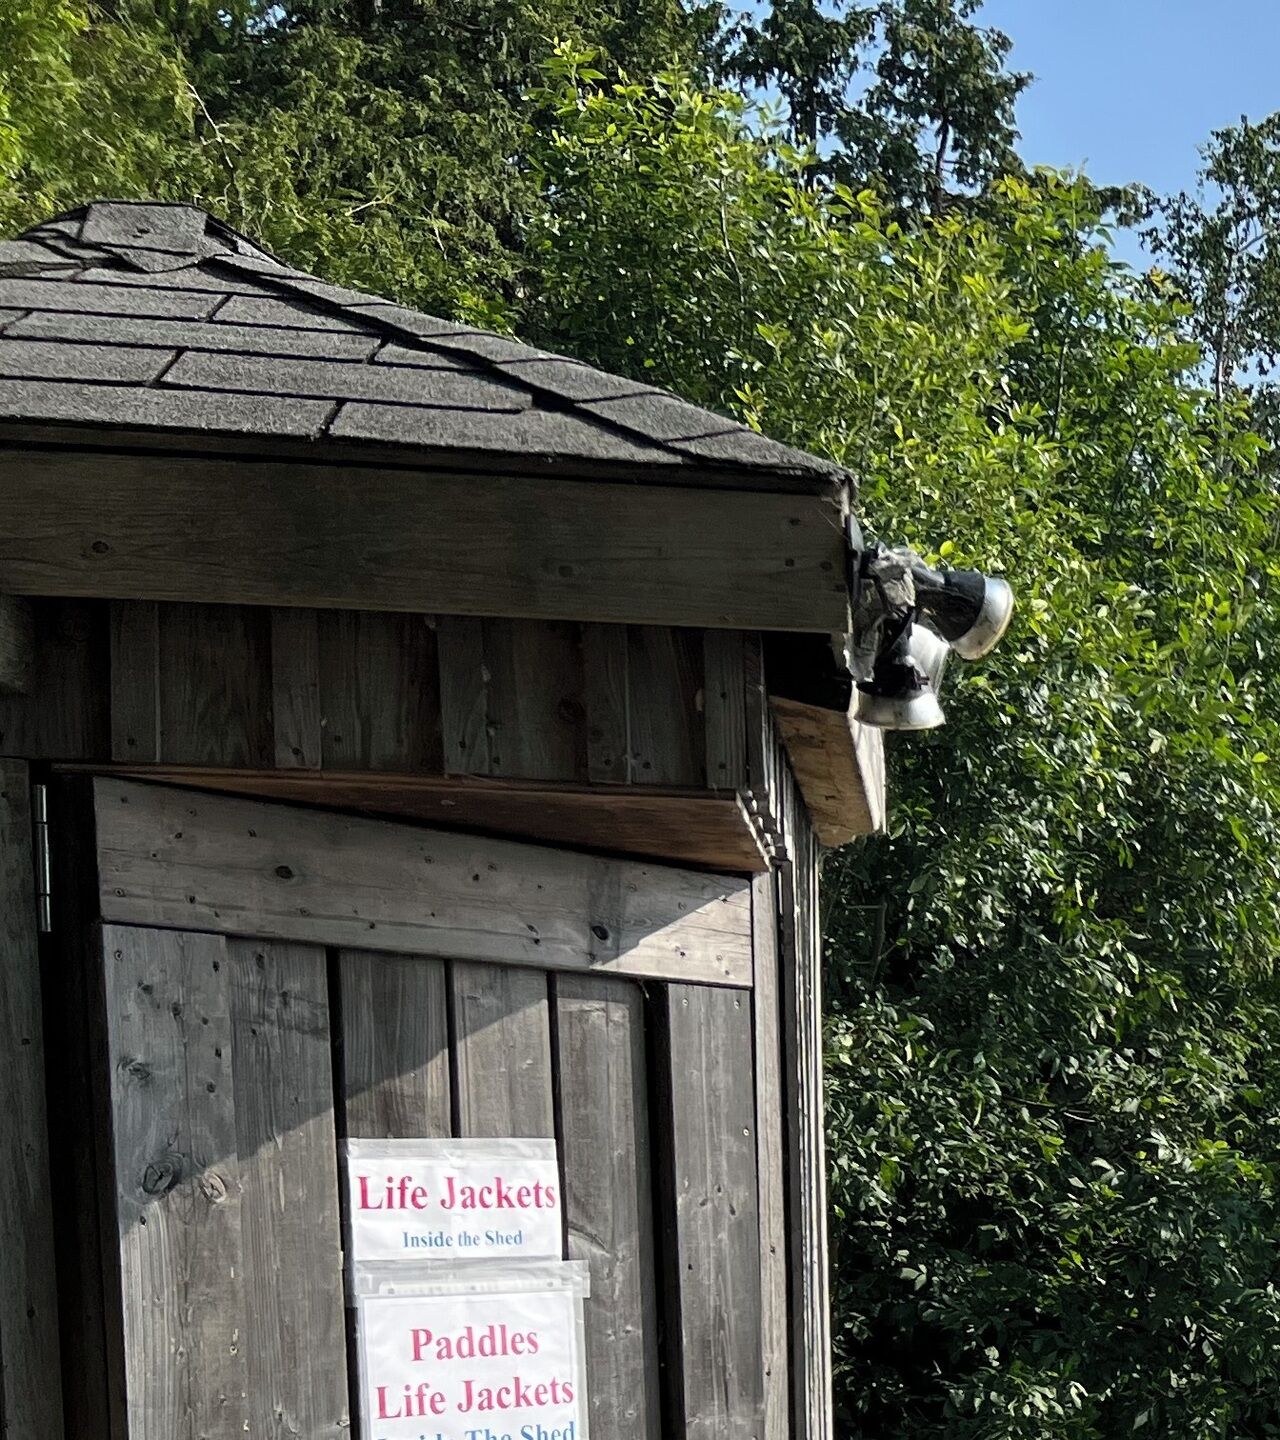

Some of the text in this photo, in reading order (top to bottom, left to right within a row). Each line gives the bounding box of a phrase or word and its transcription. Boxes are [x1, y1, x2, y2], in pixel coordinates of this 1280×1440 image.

[356, 1175, 556, 1210] Life Jackets
[402, 1230, 523, 1248] Inside the Shed
[409, 1324, 539, 1361] Paddles
[375, 1376, 574, 1419] Life Jackets
